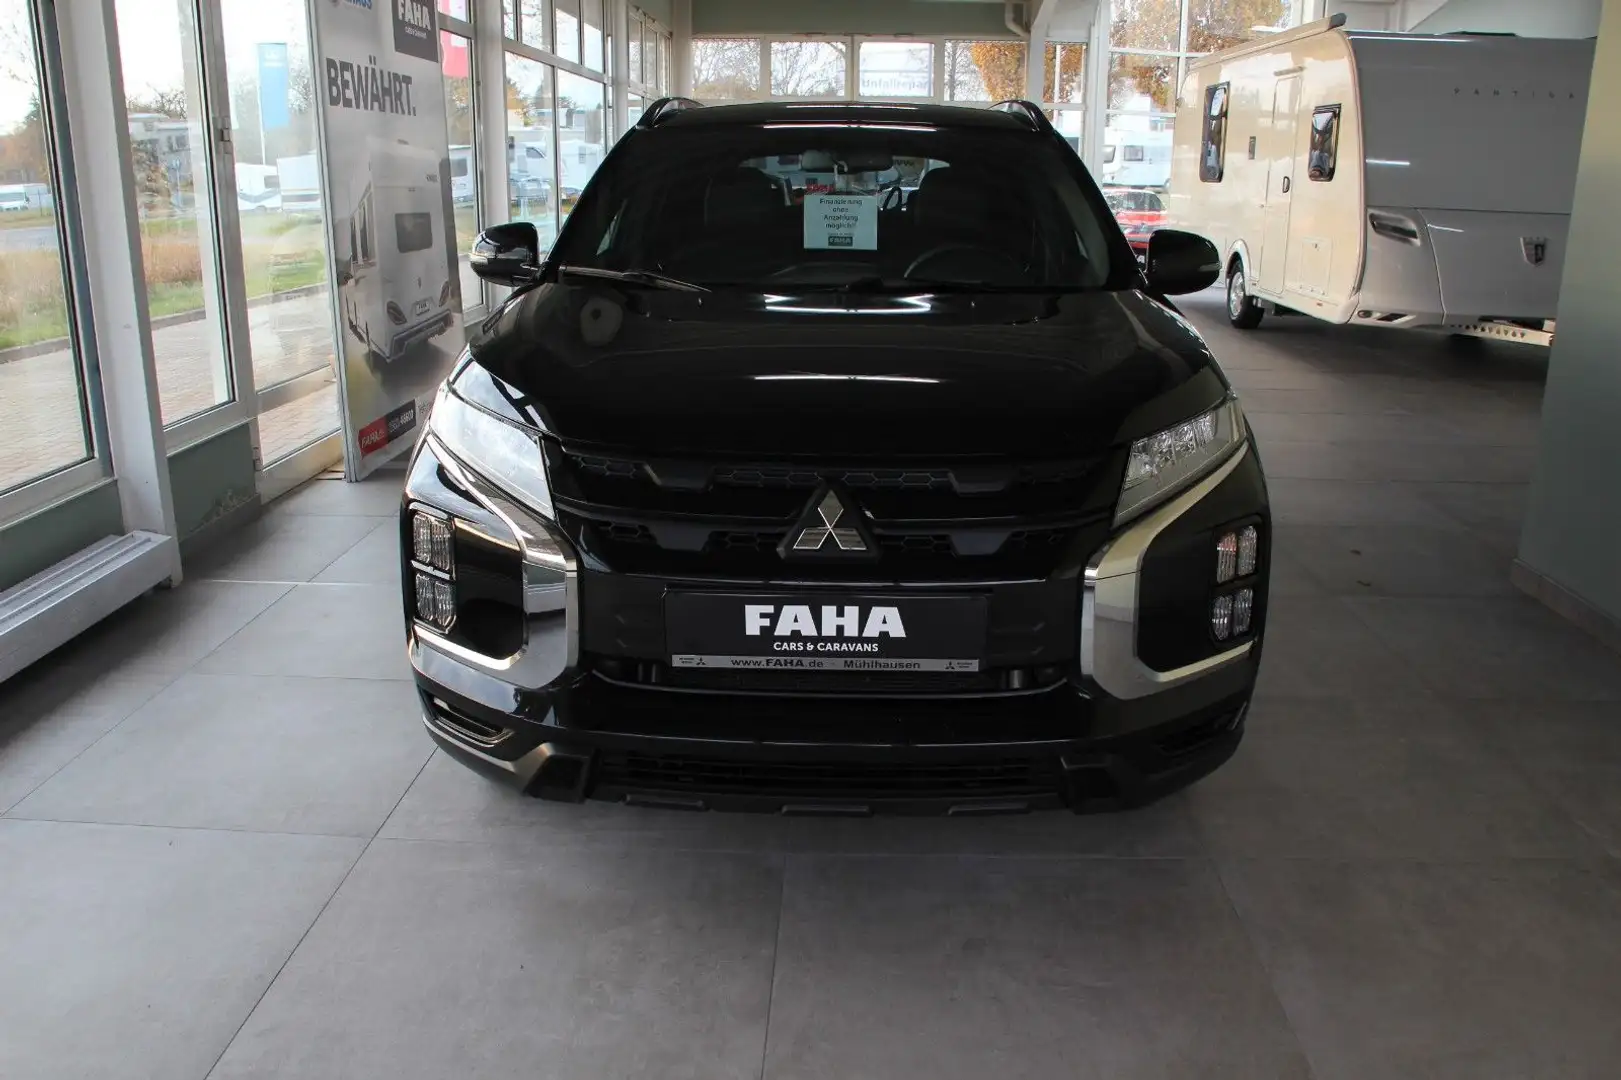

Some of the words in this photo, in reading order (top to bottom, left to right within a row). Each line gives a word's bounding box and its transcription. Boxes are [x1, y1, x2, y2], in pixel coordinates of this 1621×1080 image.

[398, 0, 431, 31] FAHA
[326, 54, 416, 117] BEWÄHRT.
[819, 198, 863, 206] Finanzierung
[823, 214, 859, 222] Anzahlung
[744, 604, 907, 638] FAHA
[773, 641, 804, 651] CARS
[806, 642, 814, 651] &
[817, 642, 879, 652] CARAVANS
[731, 658, 824, 668] www.FAHA.de
[843, 659, 921, 669] Mühlhausen
